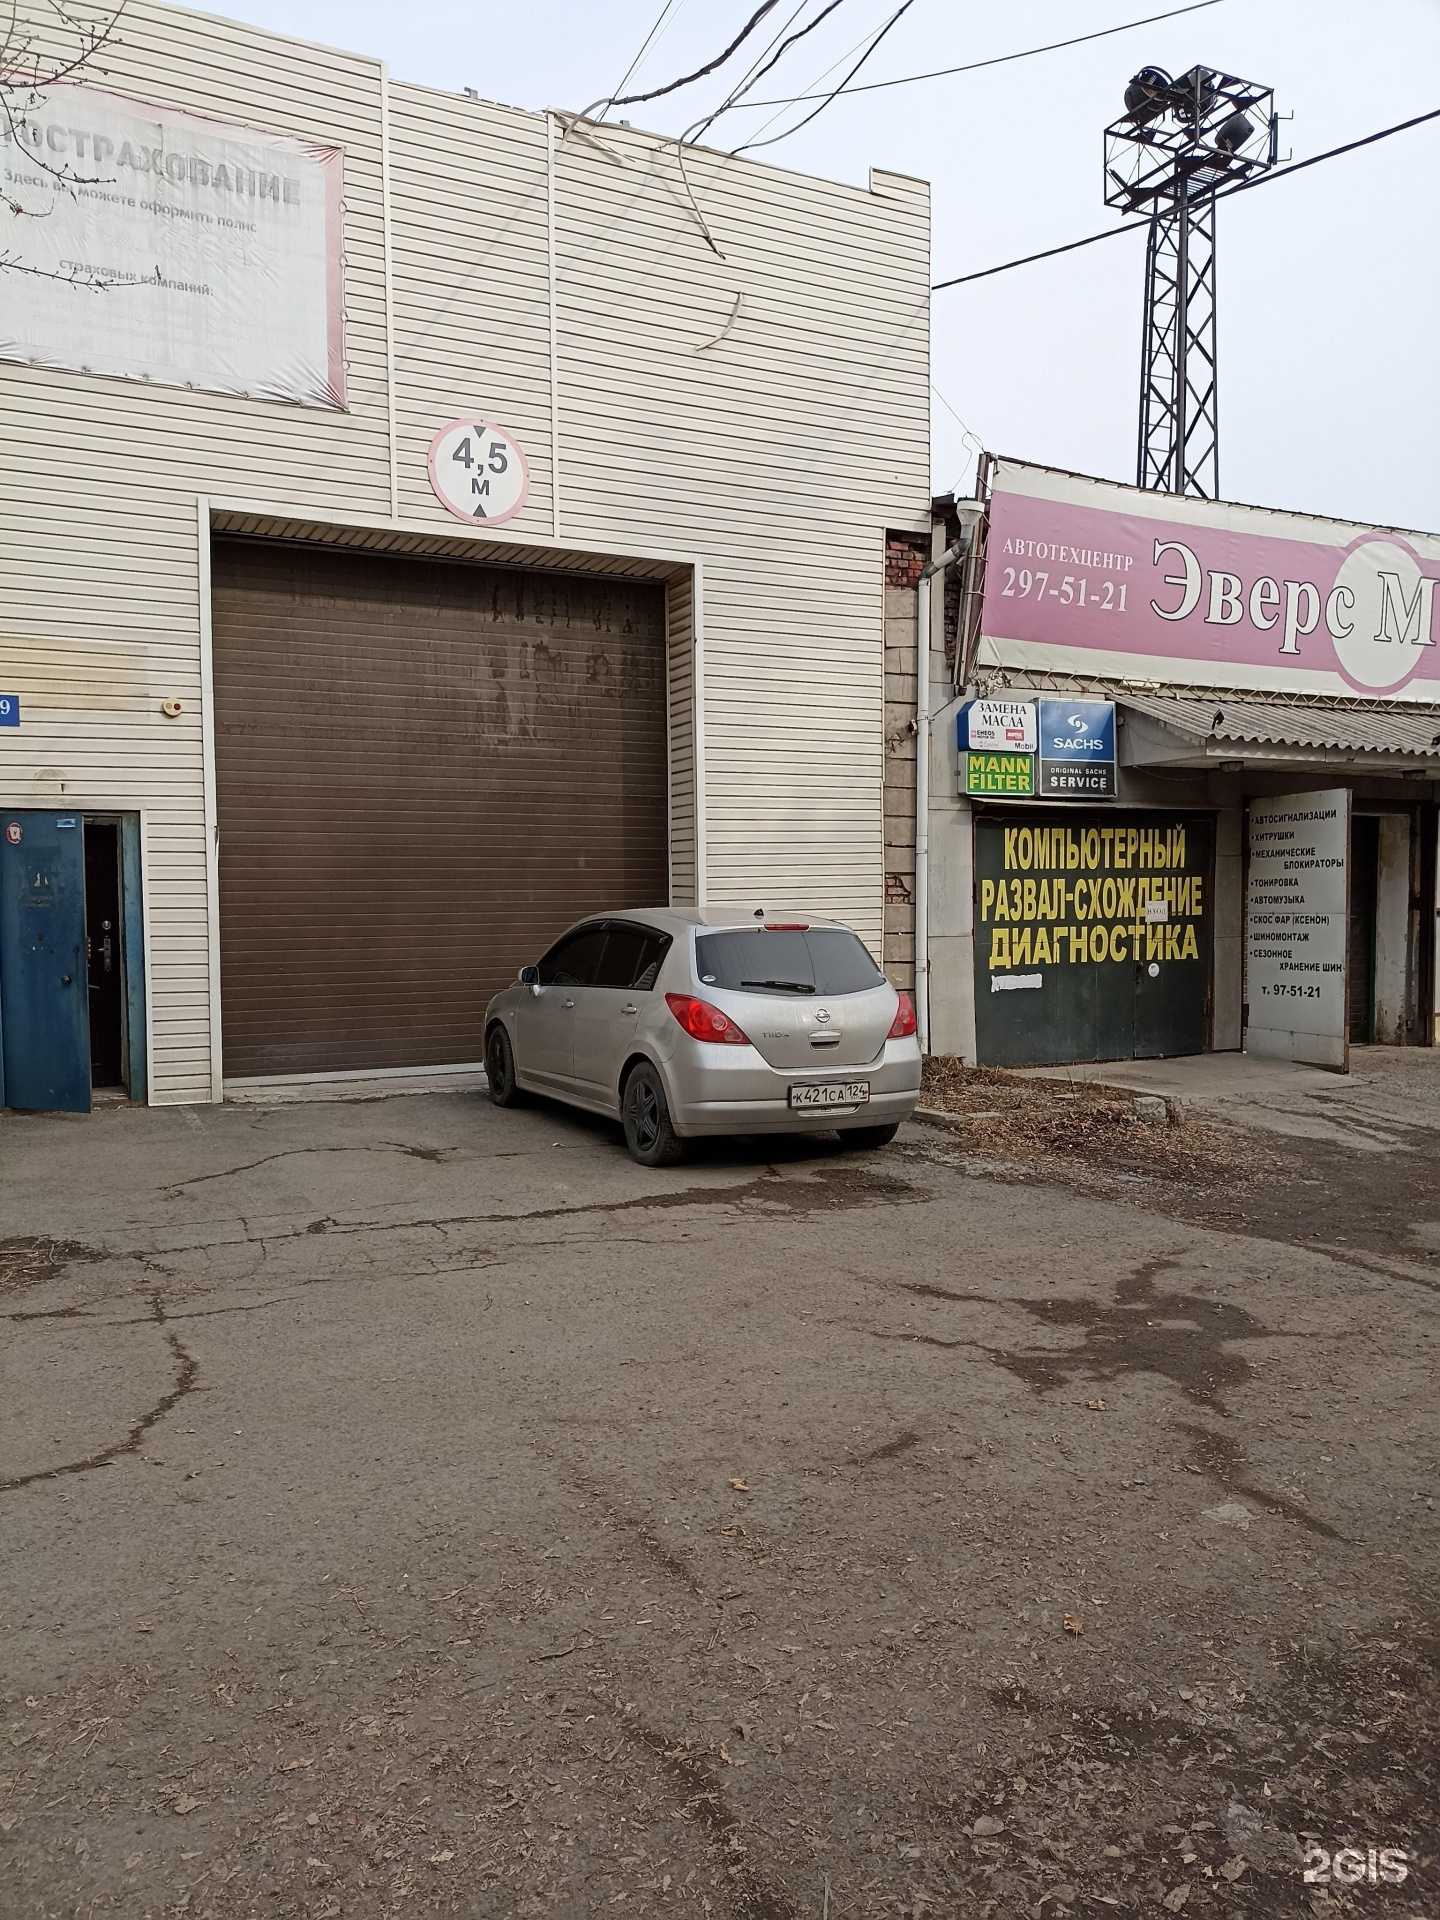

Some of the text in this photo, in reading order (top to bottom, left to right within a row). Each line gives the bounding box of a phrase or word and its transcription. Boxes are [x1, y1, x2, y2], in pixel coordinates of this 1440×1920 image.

[4, 167, 48, 189] Здесь
[78, 185, 137, 208] можете
[139, 199, 214, 226] оформить
[217, 216, 257, 233] полис
[59, 259, 137, 282] страховых
[452, 437, 508, 476] 4,5
[471, 478, 490, 496] М
[1003, 537, 1134, 572] АВТОТЕХЦЕНТР
[1001, 567, 1128, 612] 297-51-21
[1150, 537, 1355, 655] Эверс
[978, 702, 1027, 715] ЗАМЕНА
[982, 714, 1024, 728] МАСЛА
[1053, 738, 1103, 750] SACHS
[969, 756, 1030, 773] MANN
[1050, 767, 1082, 775] ORIGINAL
[969, 773, 1030, 791] FILTER
[1050, 776, 1107, 789] SERVICE
[1254, 809, 1337, 825] АВТОСИГНАЛИЗАЦИИ
[1254, 831, 1295, 842] ХИТРУШКИ
[1004, 824, 1186, 870] КОМПЬЮТЕРНЫЙ
[1255, 848, 1316, 859] МЕХАНИЧЕСКИЕ
[1284, 859, 1344, 870] БЛОКИРАТОРЫ
[1254, 878, 1299, 888] ТОНИРОВКА
[981, 876, 1202, 922] РАЗВАЛ-СХОЖДЕНИЕ
[1254, 895, 1305, 905] АВТОМУЗЫКА
[1253, 915, 1330, 926] СКОС ФАР (КСЕНОН)
[1253, 932, 1309, 942] ШИНОМОНТАЖ
[988, 924, 1199, 970] ДИАГНОСТИКА
[1253, 950, 1293, 959] СЕЗОННОЕ
[1279, 962, 1320, 972] ХРАНЕНИЕ
[1273, 985, 1321, 998] 97-51-21
